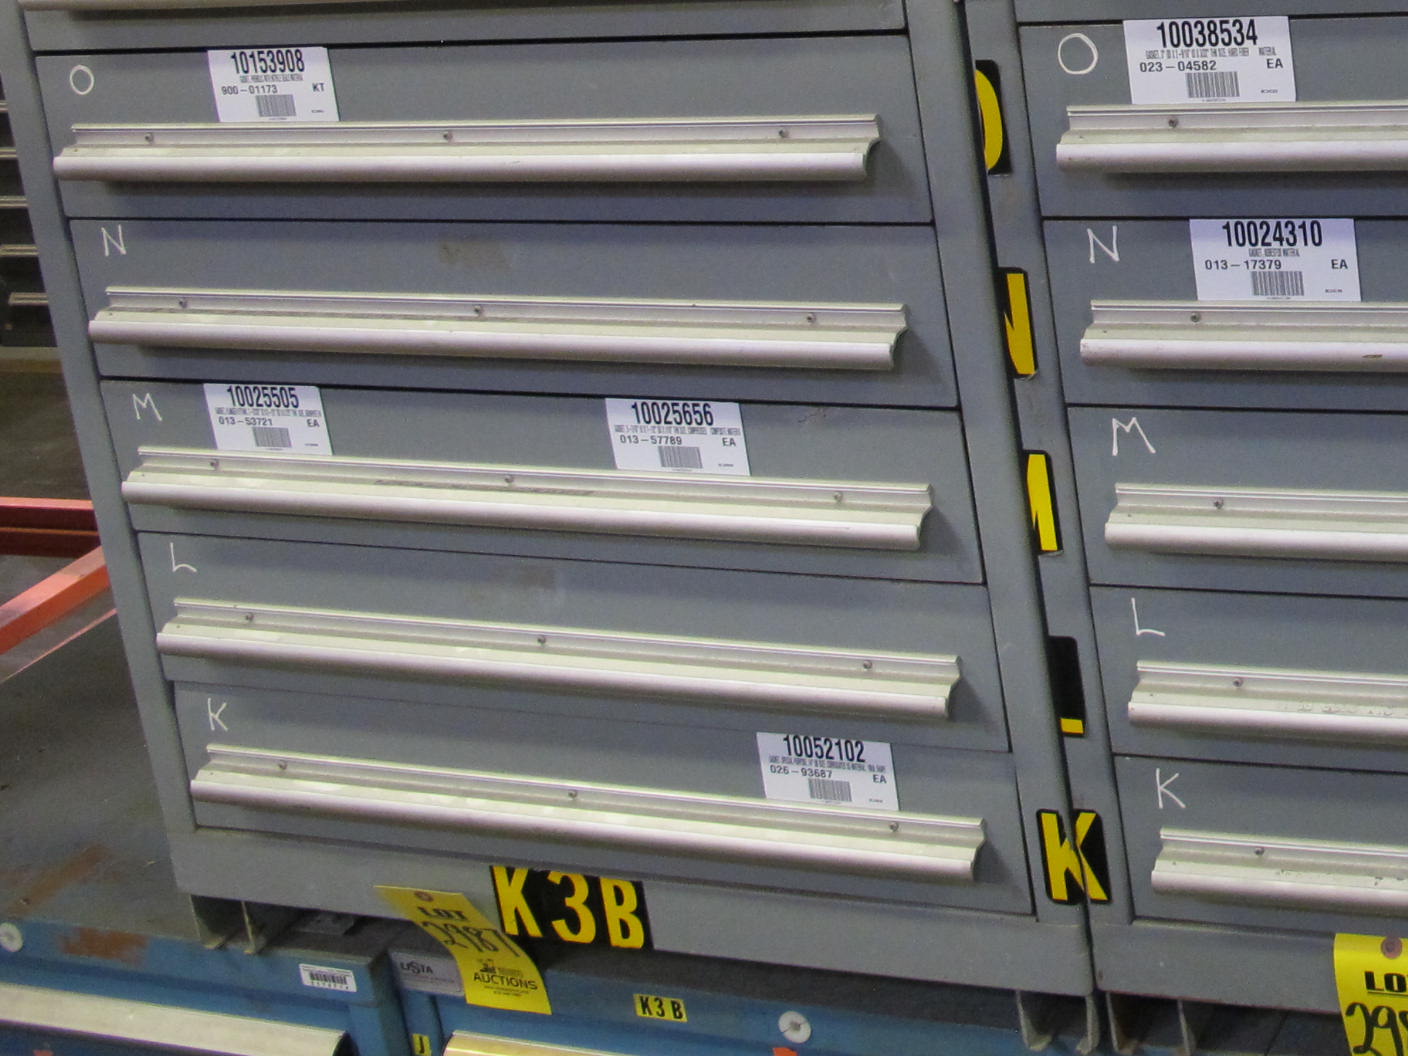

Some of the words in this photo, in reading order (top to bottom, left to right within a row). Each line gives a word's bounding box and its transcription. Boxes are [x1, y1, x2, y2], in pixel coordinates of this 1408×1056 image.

[1157, 19, 1258, 48] 10038534
[230, 49, 305, 74] 10153908
[1266, 58, 1283, 69] EA
[312, 82, 325, 92] KT
[100, 224, 127, 256] N
[1087, 225, 1120, 264] N
[1222, 220, 1323, 247] 10024310
[1331, 258, 1348, 270] EA
[131, 392, 163, 422] M
[227, 385, 299, 409] 10025505
[306, 419, 320, 428] EA
[631, 401, 714, 426] 10025656
[721, 437, 737, 447] EA
[1112, 416, 1156, 457] M
[170, 542, 197, 574] L
[1131, 597, 1165, 637] L
[206, 697, 228, 731] K
[783, 734, 866, 763] 10052102
[873, 774, 887, 784] EA
[1155, 768, 1186, 809] K
[1039, 811, 1108, 901] K
[416, 905, 469, 923] LOT
[492, 865, 645, 950] K3B
[473, 972, 538, 991] AUCTIONS
